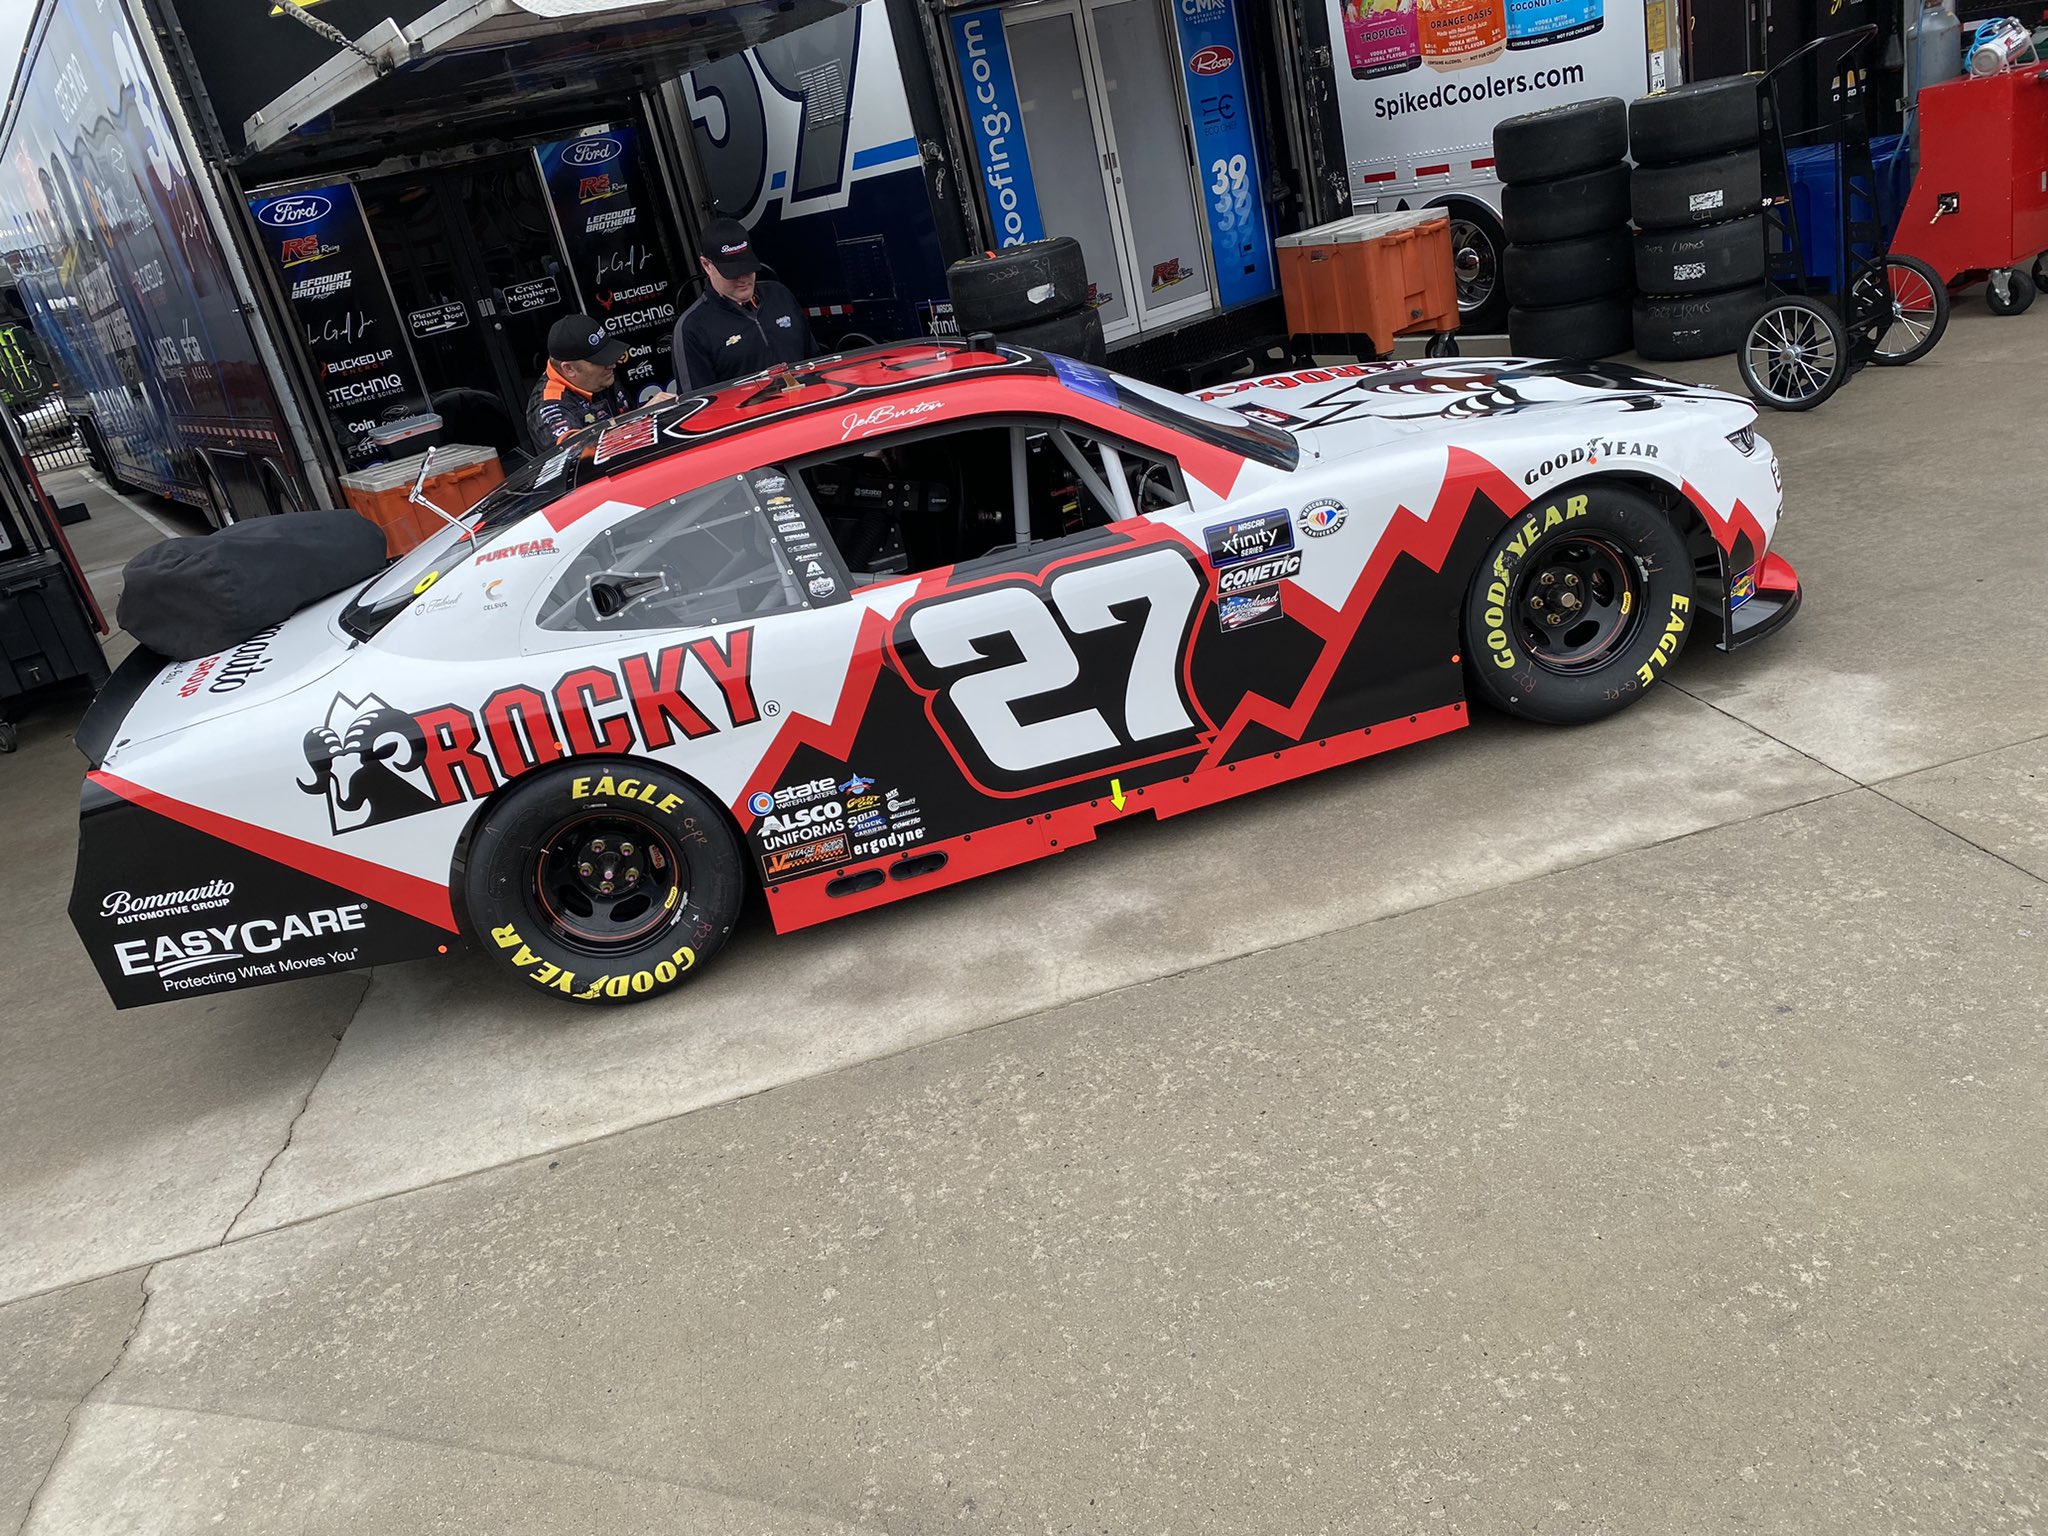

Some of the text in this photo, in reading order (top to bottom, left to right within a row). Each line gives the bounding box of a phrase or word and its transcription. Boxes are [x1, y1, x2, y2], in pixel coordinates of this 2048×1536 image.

[1430, 7, 1492, 29] ORANGE OASIS
[1360, 25, 1407, 42] TROPICAL
[1374, 63, 1585, 121] SpikedCoolers.com
[574, 142, 611, 163] Ford
[1211, 154, 1247, 195] 39
[274, 200, 318, 223] Ford
[1762, 198, 1773, 206] 39
[586, 215, 636, 233] BROTHERS
[587, 207, 637, 225] LEFCOURT
[292, 279, 351, 300] BROTHERS
[293, 270, 352, 290] LEFCOURT
[515, 282, 543, 294] Crew
[613, 280, 668, 302] BUCKED UP
[507, 286, 556, 303] Members
[522, 297, 545, 308] Only
[412, 304, 462, 321] Please Use
[413, 311, 465, 329] Other Door
[605, 303, 675, 331] GTECHNIQ
[928, 315, 958, 338] xfinit
[327, 349, 393, 374] BUCKED UP
[628, 344, 652, 358] Coin
[627, 364, 653, 377] FGR
[346, 394, 376, 406] SURFACE
[378, 387, 406, 399] SCIENCE
[348, 419, 376, 433] Coin
[1238, 518, 1265, 531] NASCAR
[475, 537, 555, 566] PURYEAR
[1221, 528, 1278, 555] xfinity
[1240, 545, 1264, 557] SERIES
[1220, 556, 1300, 589] COMETIC
[1484, 494, 1588, 669] GOODYEAR
[483, 601, 508, 611] CELSIUS
[1220, 591, 1279, 616] Arrowhead
[1636, 593, 1690, 687] EAGLE
[910, 548, 1201, 771] 27
[411, 625, 762, 805] ROCKY
[572, 776, 684, 814] EAGLE
[774, 778, 835, 803] state
[776, 789, 837, 810] WATER HEATERS
[757, 802, 842, 836] ALSCO
[847, 810, 879, 829] SOLID
[857, 818, 883, 830] ROCK
[764, 819, 845, 850] UNIFORMS
[853, 827, 924, 856] ergodyne
[854, 825, 887, 838] CARRIERS
[100, 879, 235, 918] Bommarito
[116, 898, 230, 926] AUTOMOTIVE GROUP
[491, 923, 695, 999] GOODYEAR
[163, 970, 237, 992] Protecting
[238, 964, 277, 980] What
[278, 955, 327, 973] Moves
